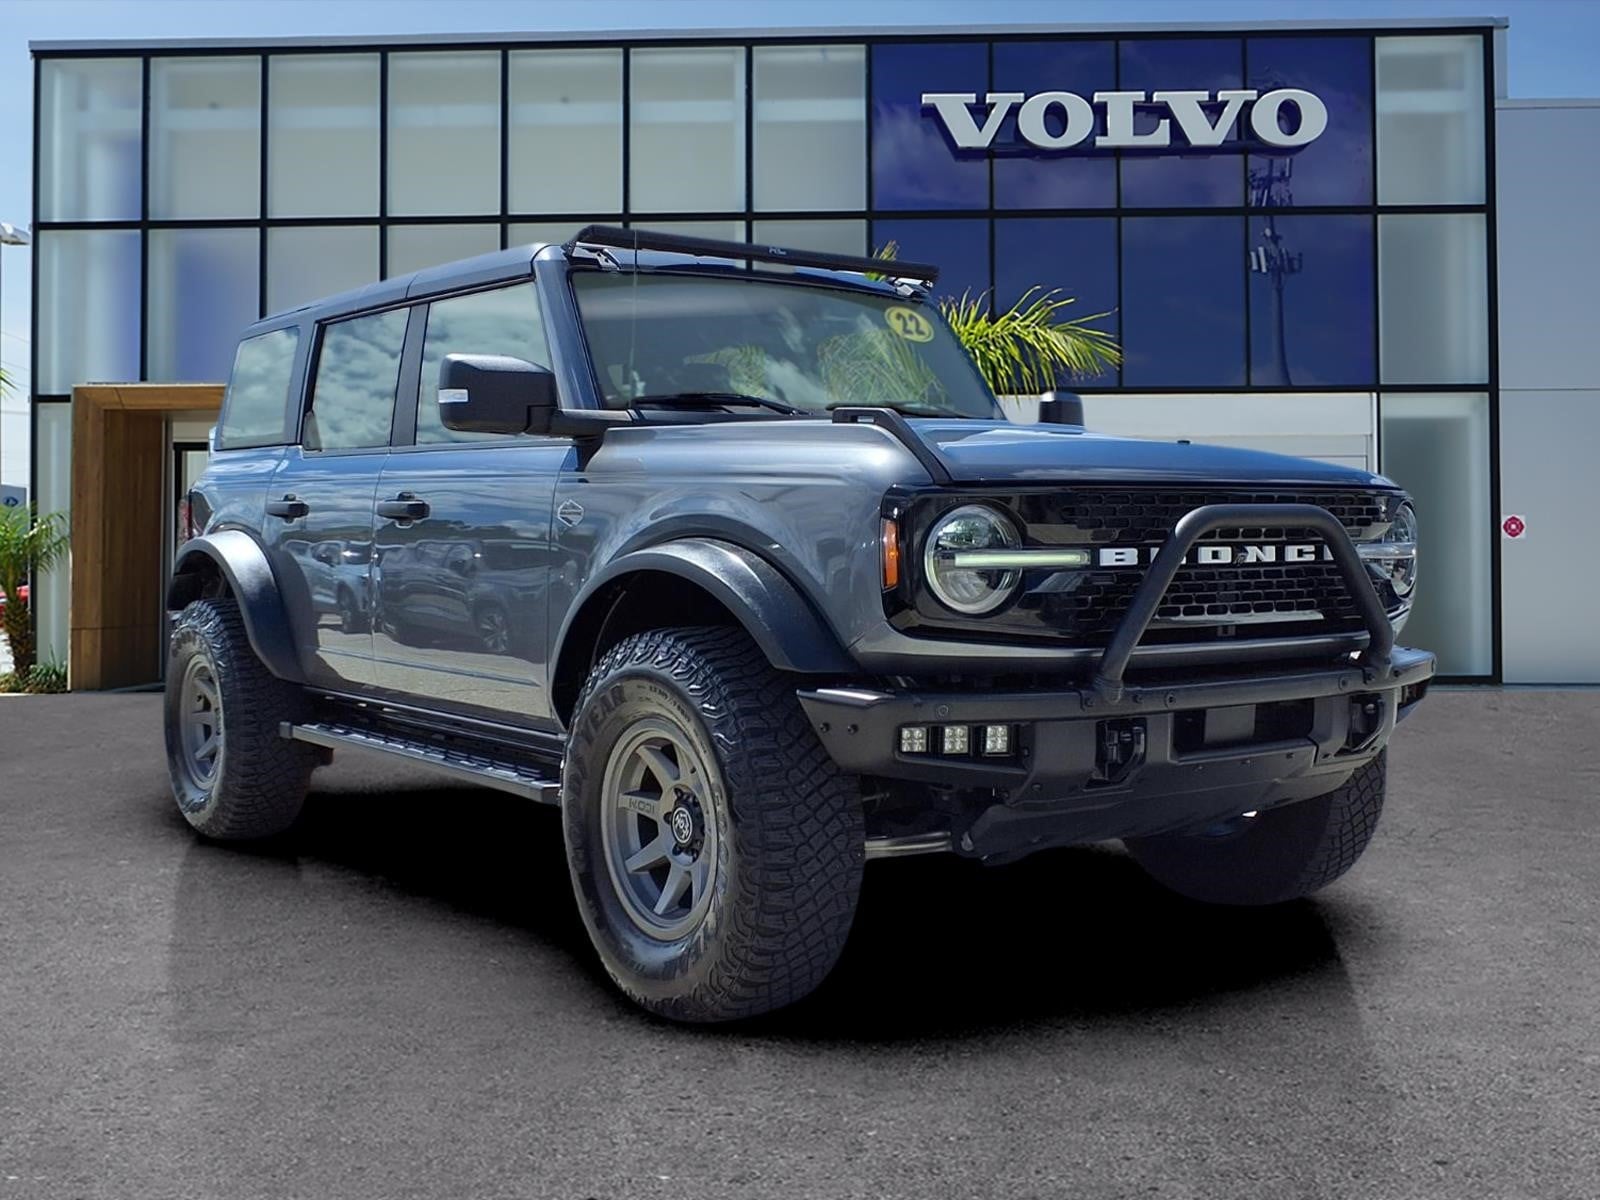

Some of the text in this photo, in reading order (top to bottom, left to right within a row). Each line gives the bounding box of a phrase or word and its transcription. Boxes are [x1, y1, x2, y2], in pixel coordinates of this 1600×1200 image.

[922, 89, 1328, 149] VOLVO
[895, 312, 926, 336] 22
[1100, 545, 1334, 566] BONC
